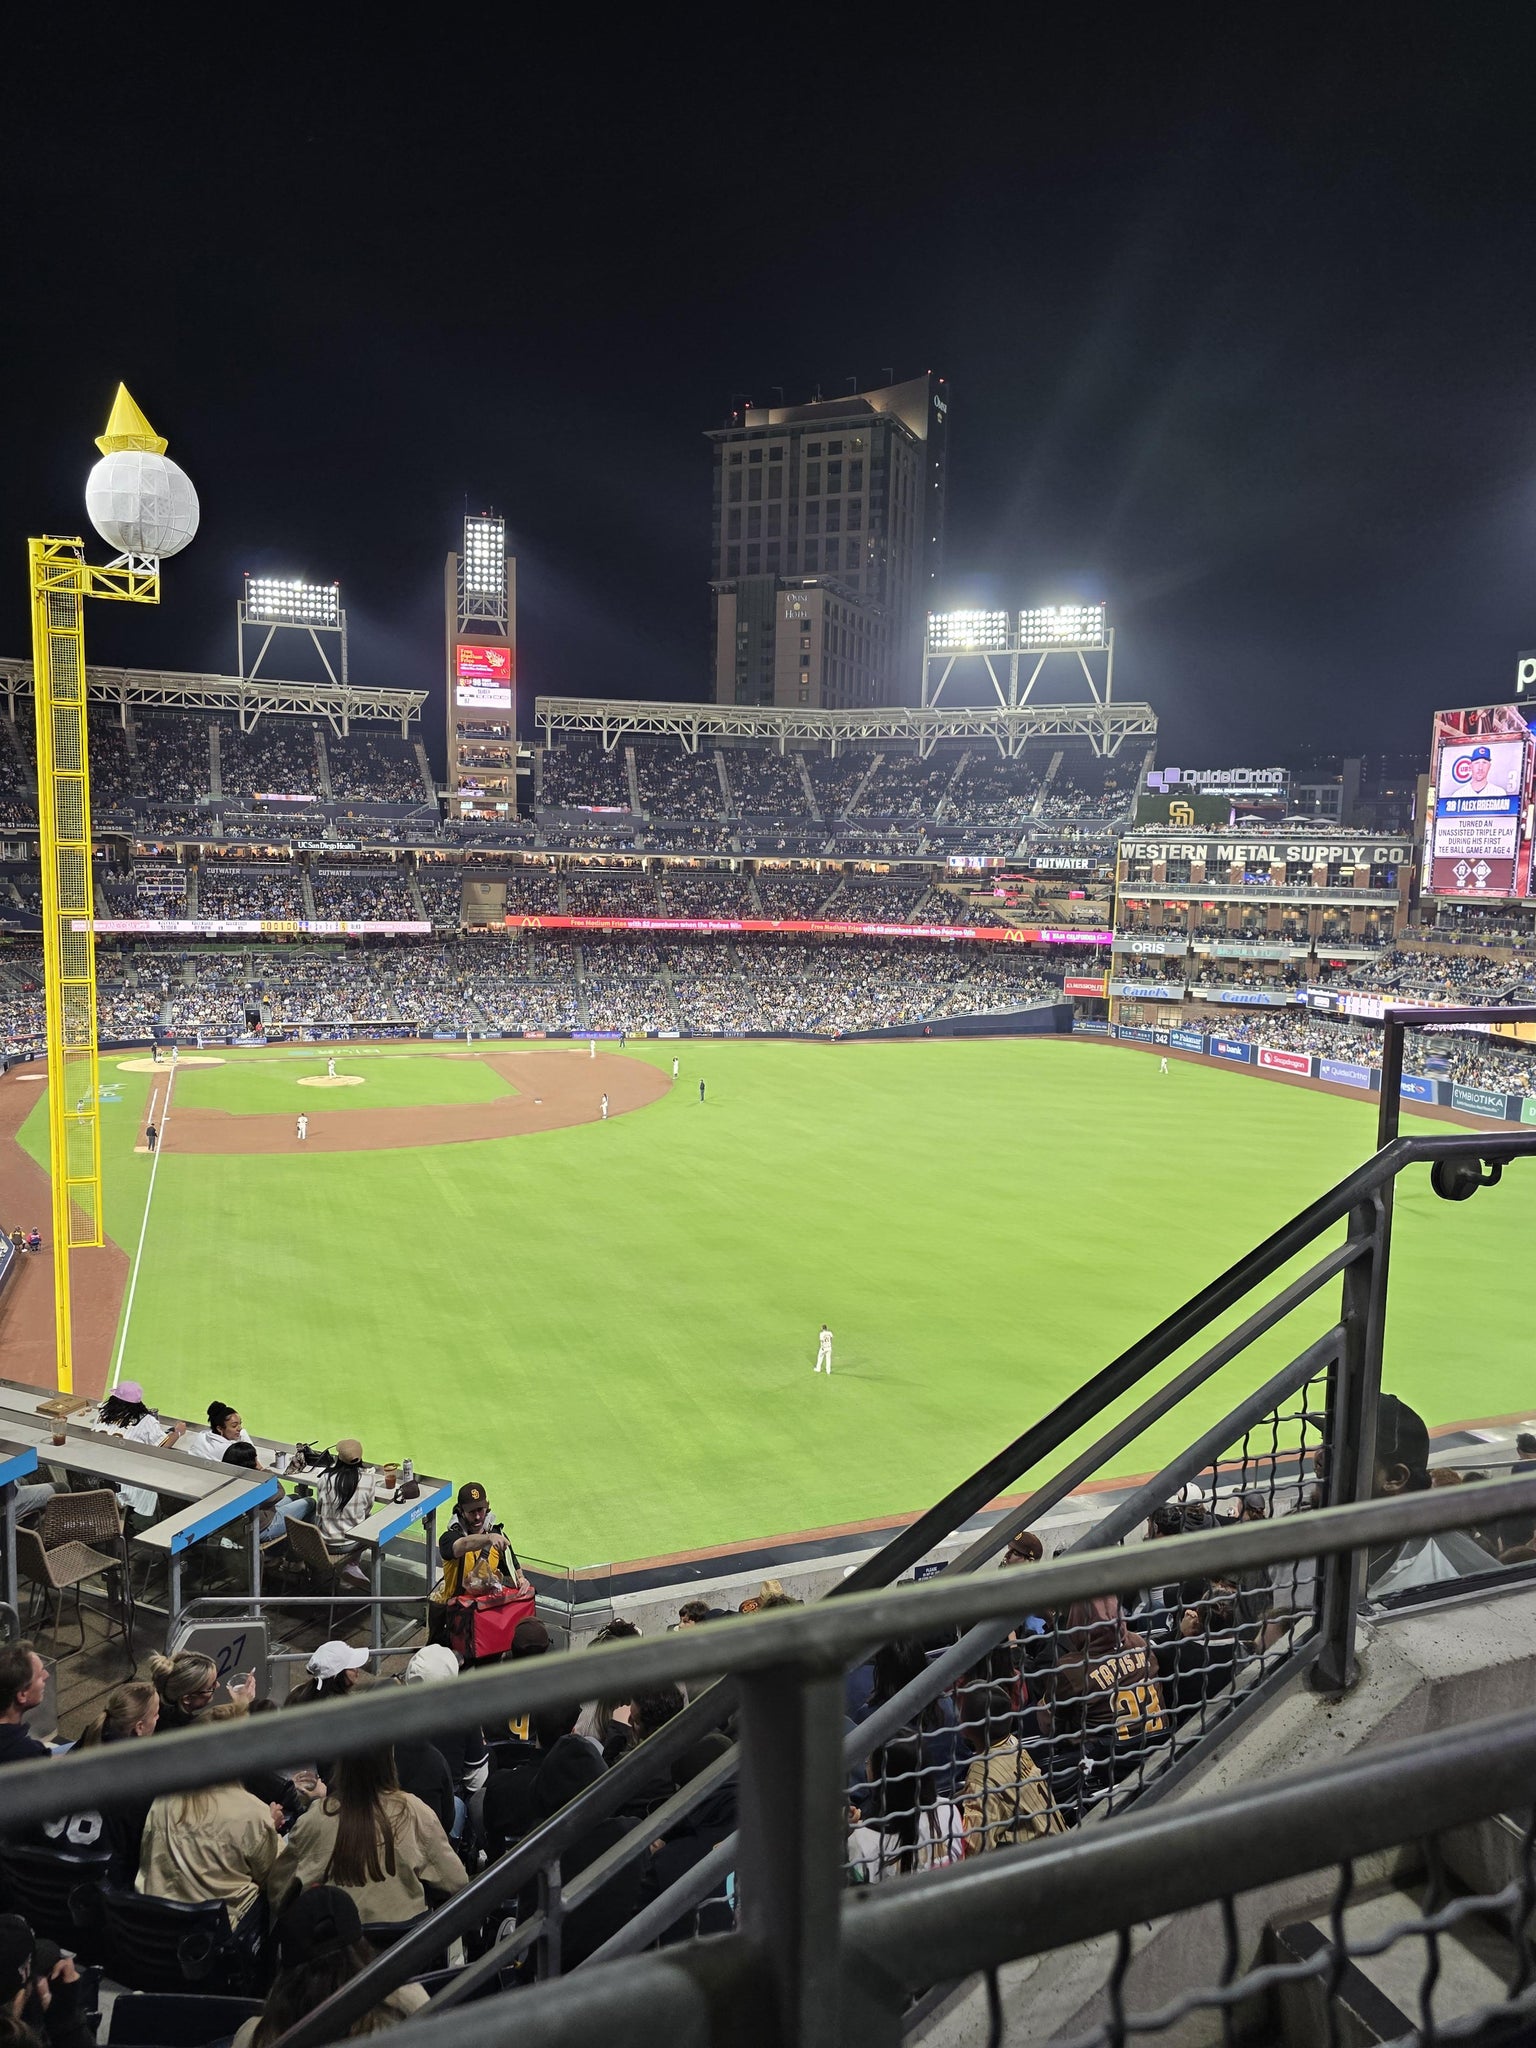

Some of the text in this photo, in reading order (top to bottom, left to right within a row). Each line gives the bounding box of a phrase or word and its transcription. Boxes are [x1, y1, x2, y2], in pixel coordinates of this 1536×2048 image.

[1183, 768, 1283, 787] QuidelOrtho
[1458, 820, 1494, 828] TURNED AN
[1438, 829, 1475, 838] UNASSISTED
[1497, 828, 1514, 836] PLAY
[1448, 838, 1471, 846] DURING
[1120, 844, 1410, 864] WESTERN METAL SUPPLY CO.
[1438, 846, 1511, 854] TEE BALL GAME AT AGE 4
[1036, 858, 1089, 869] CUTWATER
[1131, 942, 1165, 954] ORIS
[1122, 986, 1169, 998] Canel's
[1220, 990, 1271, 1004] Canel's
[1155, 1033, 1168, 1044] 342
[1226, 1045, 1242, 1056] bank
[1272, 1056, 1306, 1070] Snapdragon
[1330, 1066, 1368, 1082] QuidelOrtho
[216, 1633, 247, 1680] 27
